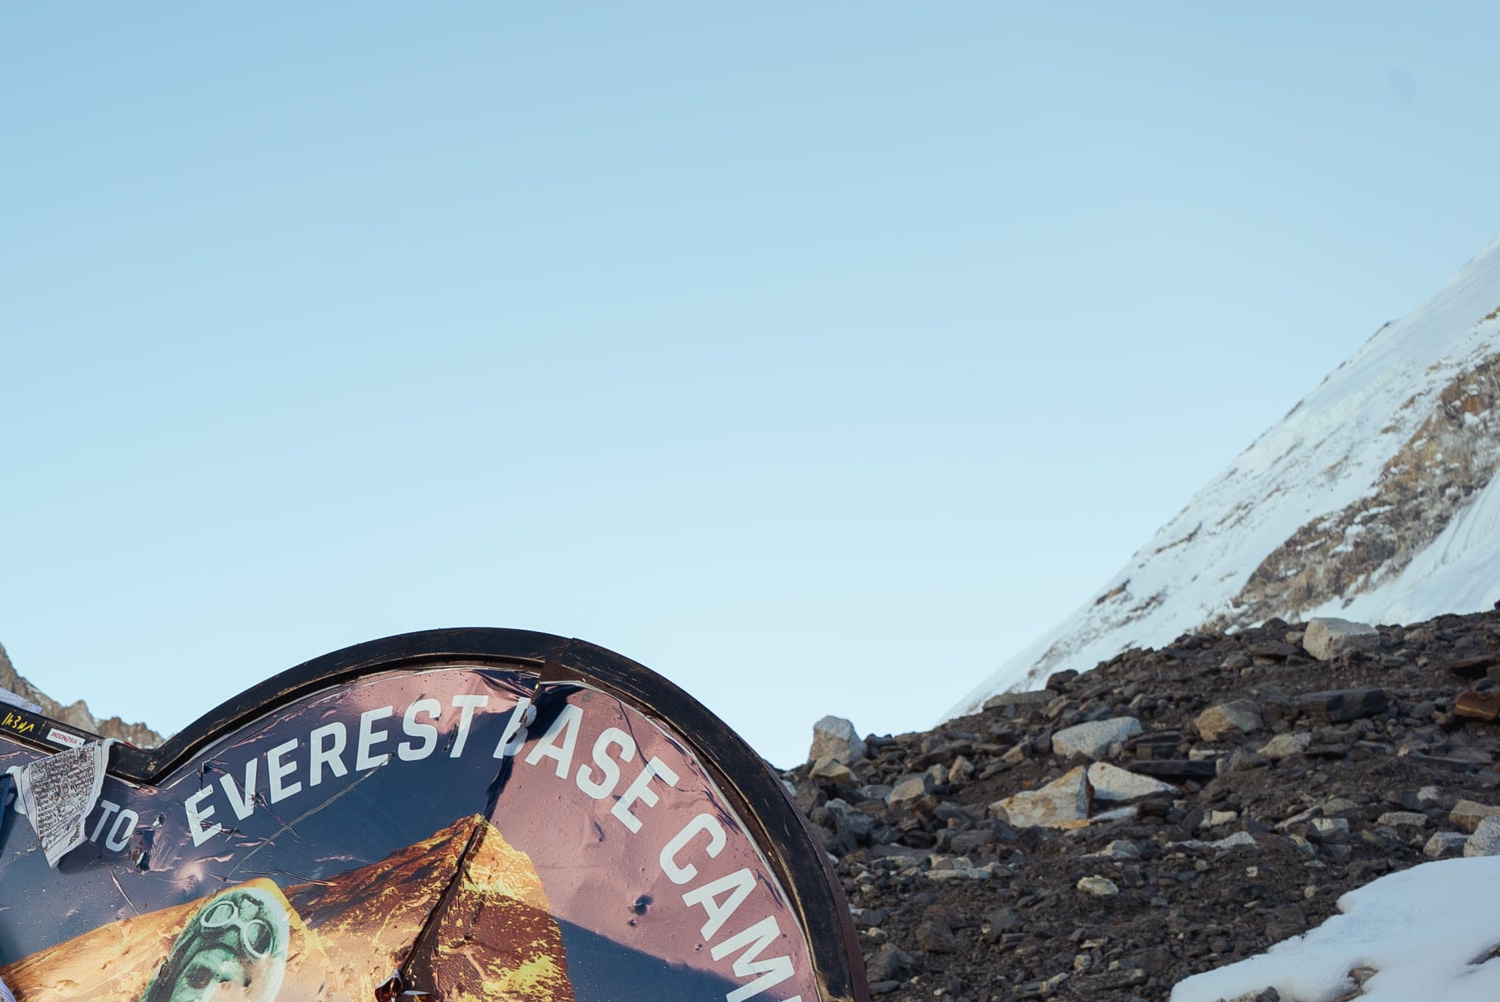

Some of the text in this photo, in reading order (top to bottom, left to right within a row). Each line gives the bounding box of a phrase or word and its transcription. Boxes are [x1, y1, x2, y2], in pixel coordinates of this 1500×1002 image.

[184, 695, 489, 847] EVEREST
[492, 696, 680, 834] BASE
[90, 799, 139, 851] TO
